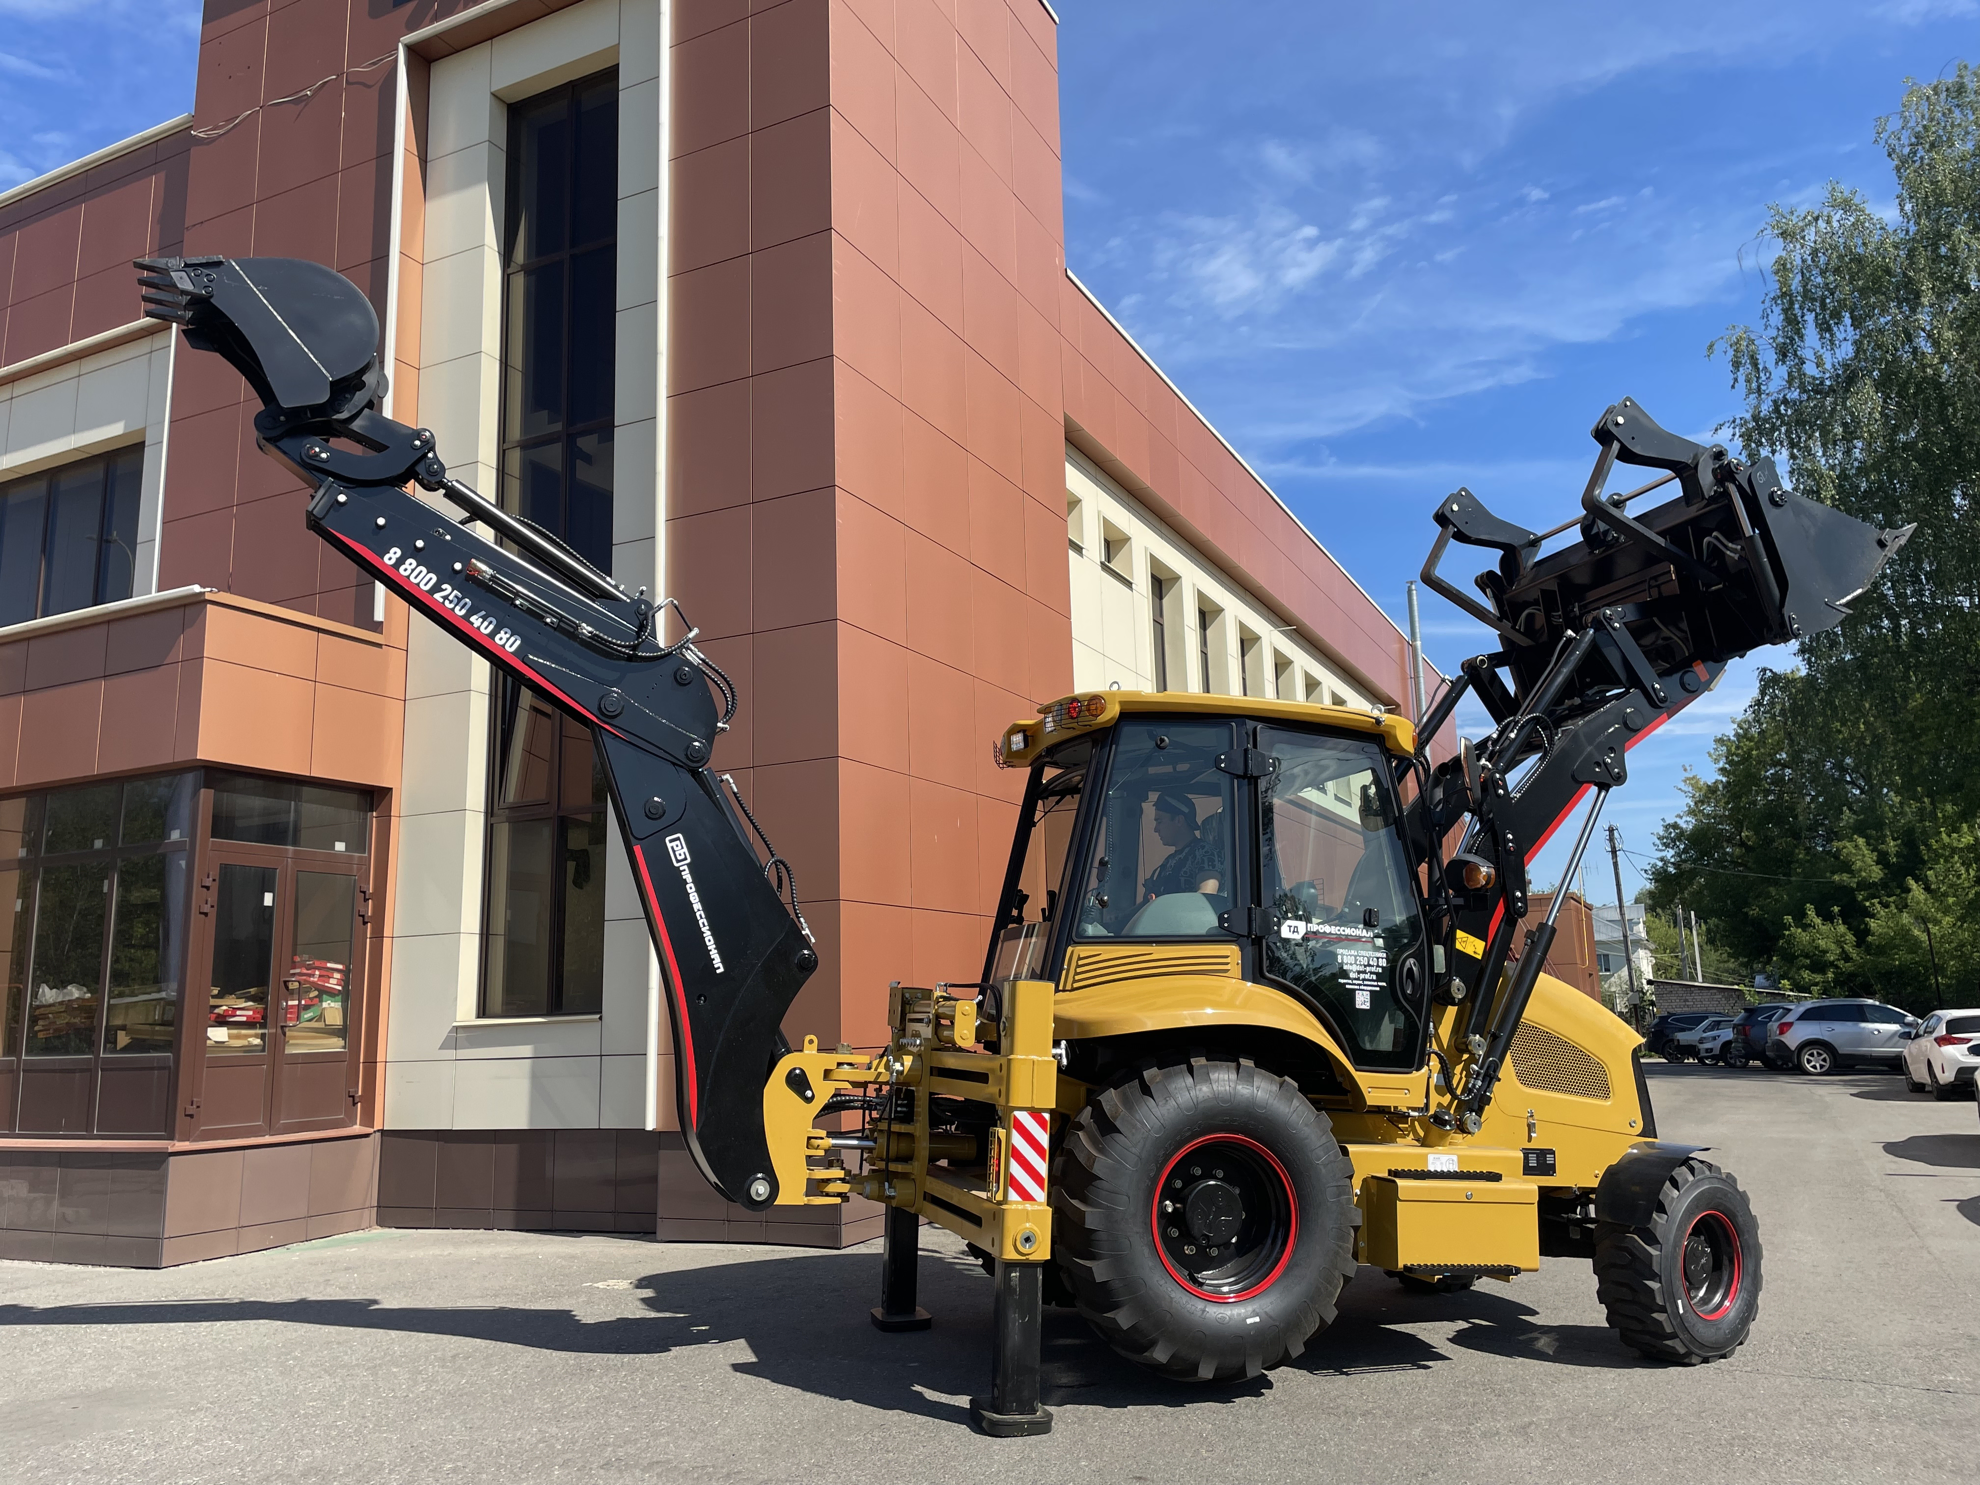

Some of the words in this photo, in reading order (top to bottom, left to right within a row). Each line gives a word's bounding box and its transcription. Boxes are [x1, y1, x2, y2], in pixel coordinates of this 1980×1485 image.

[383, 547, 402, 565] 8
[398, 558, 437, 591] 800
[433, 583, 472, 616] 250
[469, 610, 497, 634] 40
[494, 627, 521, 652] 80
[679, 865, 725, 974] ПРОФЕССИОНАЛ
[1286, 925, 1300, 935] ТД
[1307, 924, 1373, 937] ПРОФЕССИОНАЛ
[1337, 954, 1342, 963] 8
[1343, 955, 1355, 964] 800
[1356, 956, 1368, 965] 250
[1369, 957, 1378, 966] 40
[1378, 958, 1387, 966] 80
